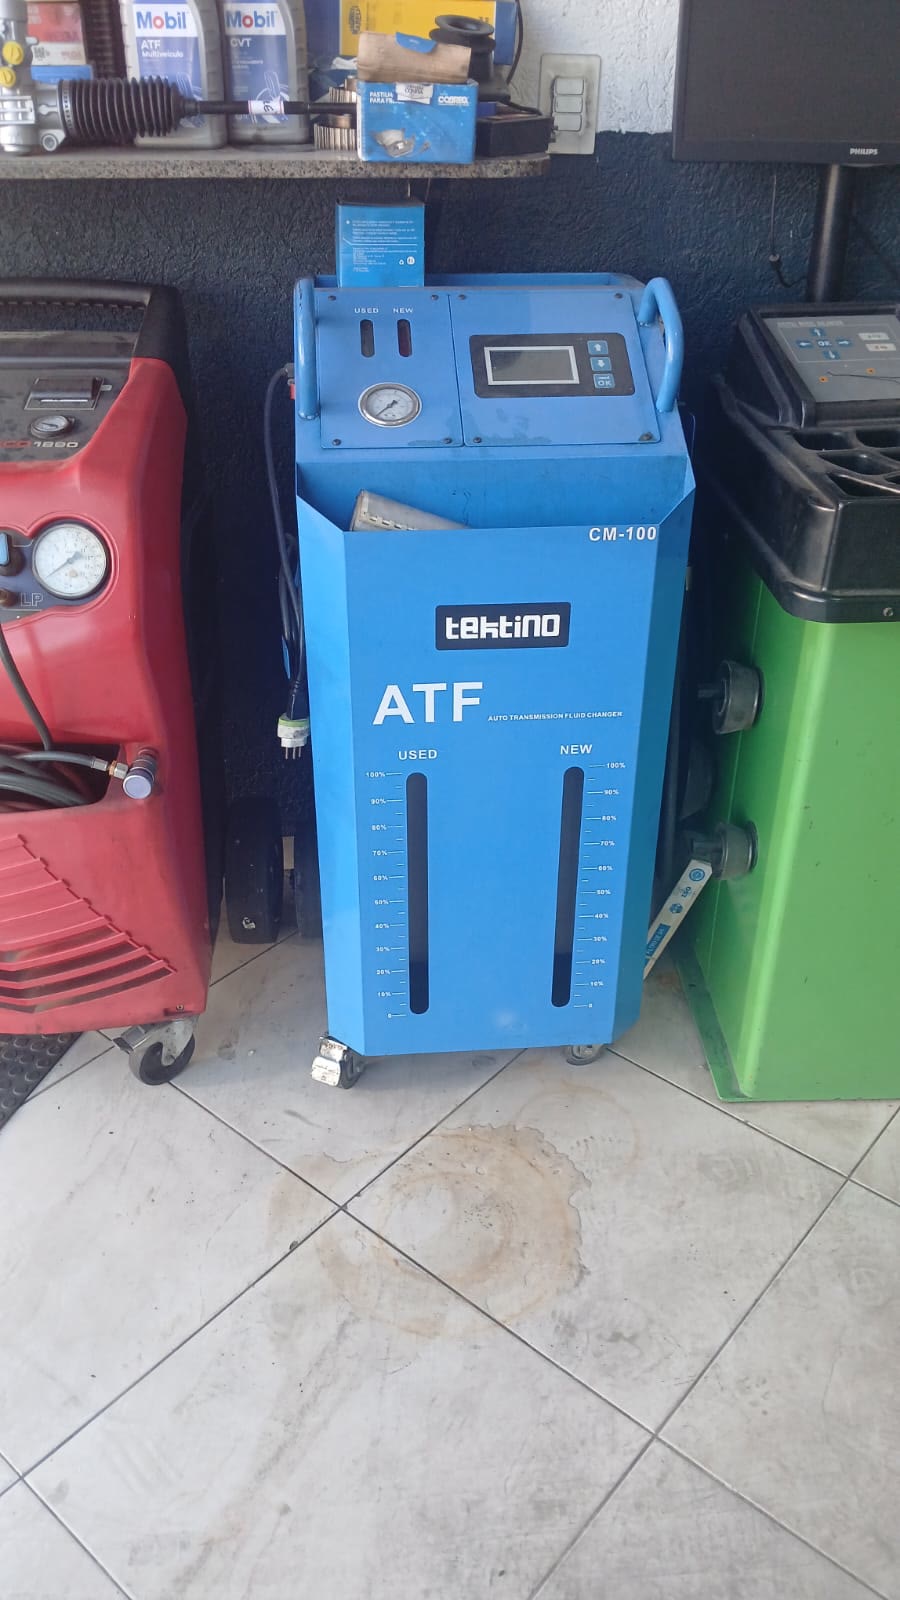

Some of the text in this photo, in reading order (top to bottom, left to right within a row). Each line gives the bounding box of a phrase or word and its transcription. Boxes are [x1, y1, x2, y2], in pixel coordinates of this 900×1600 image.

[136, 11, 187, 30] Mobil
[226, 10, 275, 28] Mobil
[141, 39, 161, 49] ATF
[230, 37, 252, 48] CVT
[850, 147, 878, 156] PHILIPS
[589, 526, 657, 541] CM-100
[21, 592, 44, 607] LP
[445, 613, 561, 640] tektino
[372, 681, 484, 726] ATF
[488, 714, 508, 722] AUTO
[510, 713, 564, 721] TRANSMISSION
[398, 749, 438, 760] USED
[560, 744, 593, 755] NEW
